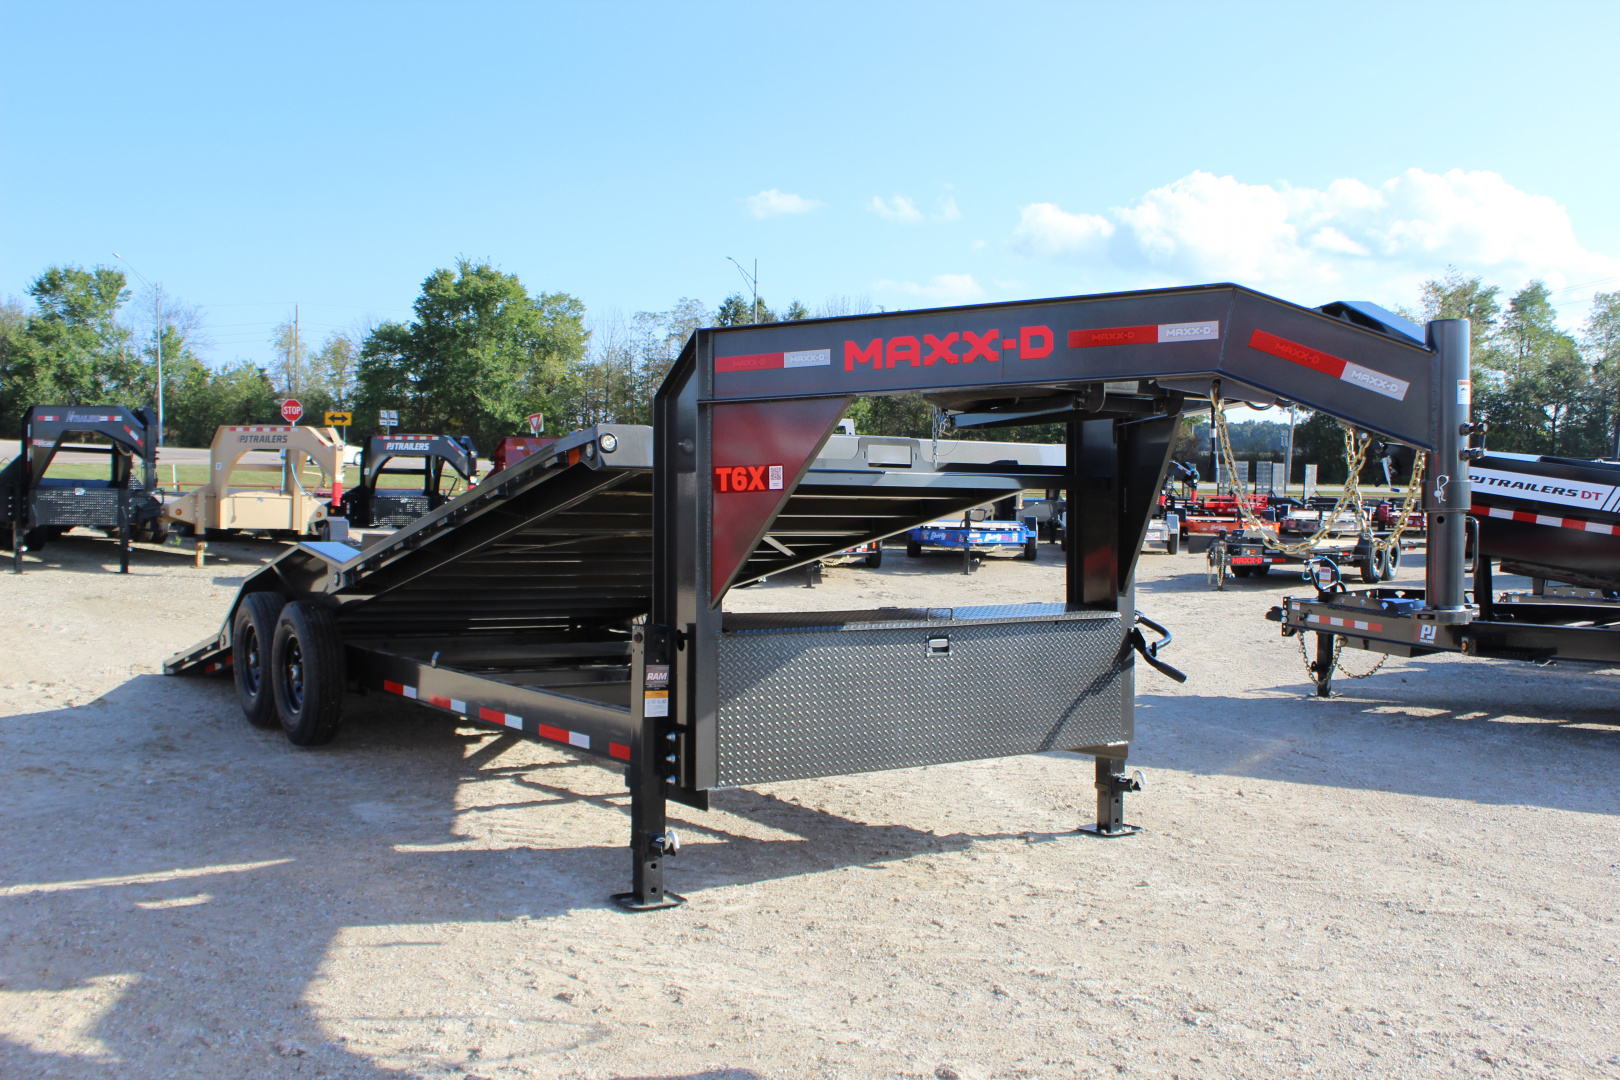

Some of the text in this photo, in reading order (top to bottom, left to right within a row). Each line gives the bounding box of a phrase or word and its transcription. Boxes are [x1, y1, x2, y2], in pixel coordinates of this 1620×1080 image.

[1092, 331, 1135, 342] MAXX-D
[1166, 326, 1211, 337] MAXX-D
[844, 325, 1054, 372] MAXX-D
[1274, 342, 1320, 364] MAXX-D
[789, 353, 825, 363] MAXX-D
[1350, 369, 1399, 393] MAXX-D
[283, 406, 301, 415] STOP
[715, 465, 766, 492] T6X
[1580, 490, 1603, 501] DT
[1231, 556, 1263, 565] MAXX-D
[1420, 624, 1437, 640] PJ
[647, 672, 668, 681] RAM
